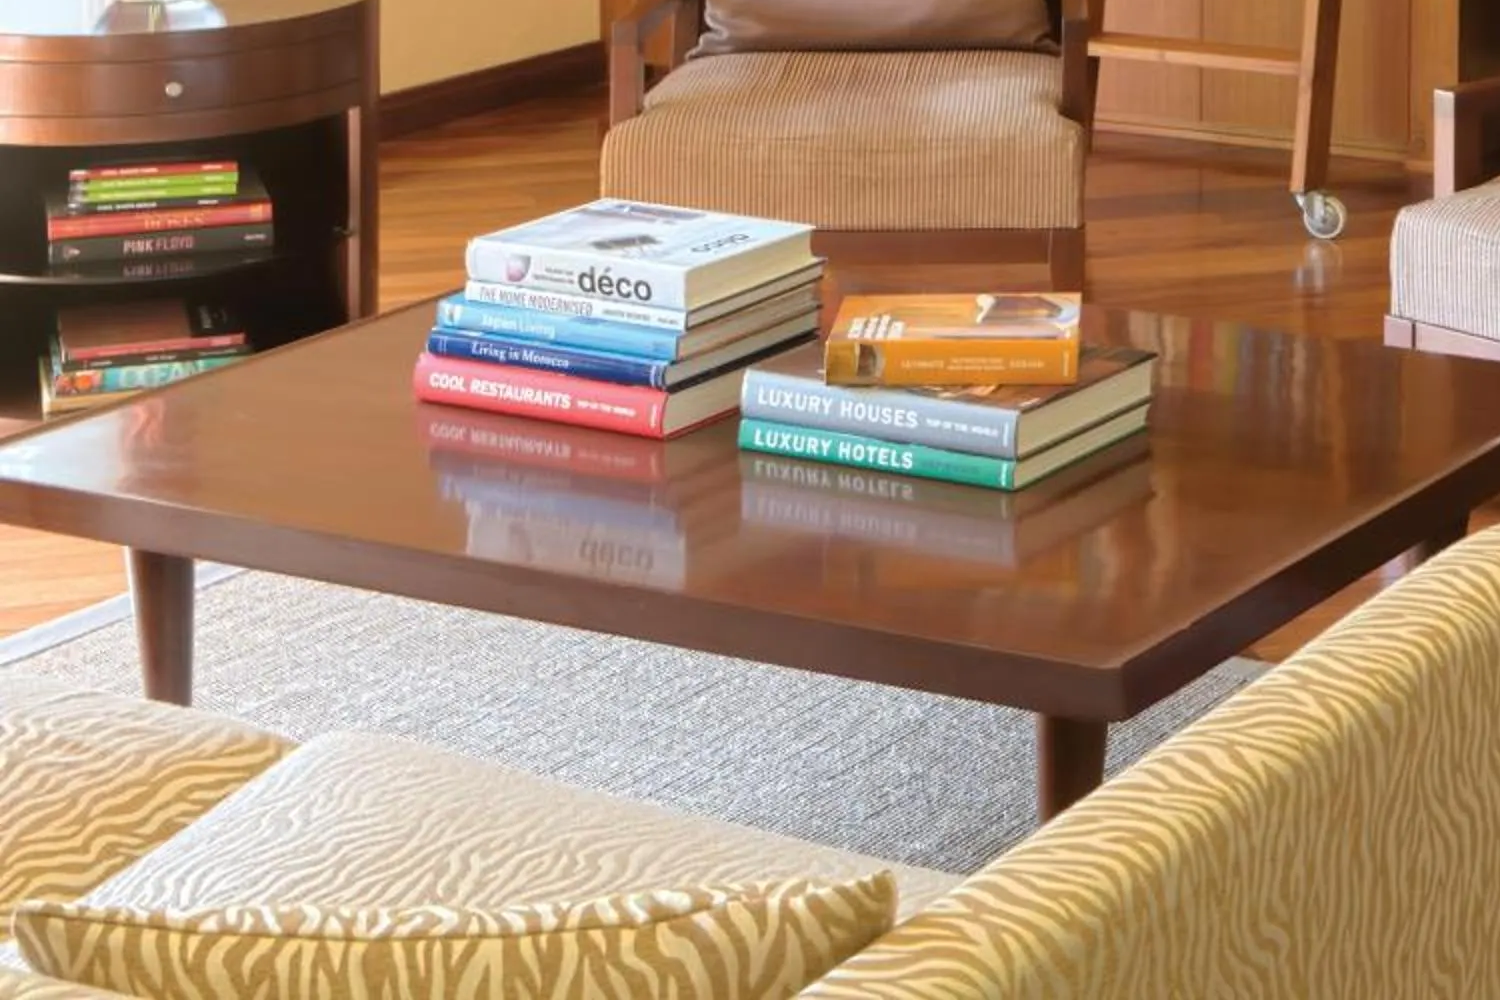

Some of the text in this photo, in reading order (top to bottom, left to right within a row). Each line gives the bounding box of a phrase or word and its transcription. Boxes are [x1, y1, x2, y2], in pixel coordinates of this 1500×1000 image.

[123, 236, 194, 254] PINK FLOYD
[578, 266, 653, 301] déco
[471, 341, 569, 369] Living in Morocco
[429, 372, 467, 393] COOL
[469, 378, 572, 410] RESTAURANTS
[757, 384, 832, 415] LUXURY
[840, 401, 919, 429] HOUSES
[753, 427, 914, 470] LUXURY HOTELS
